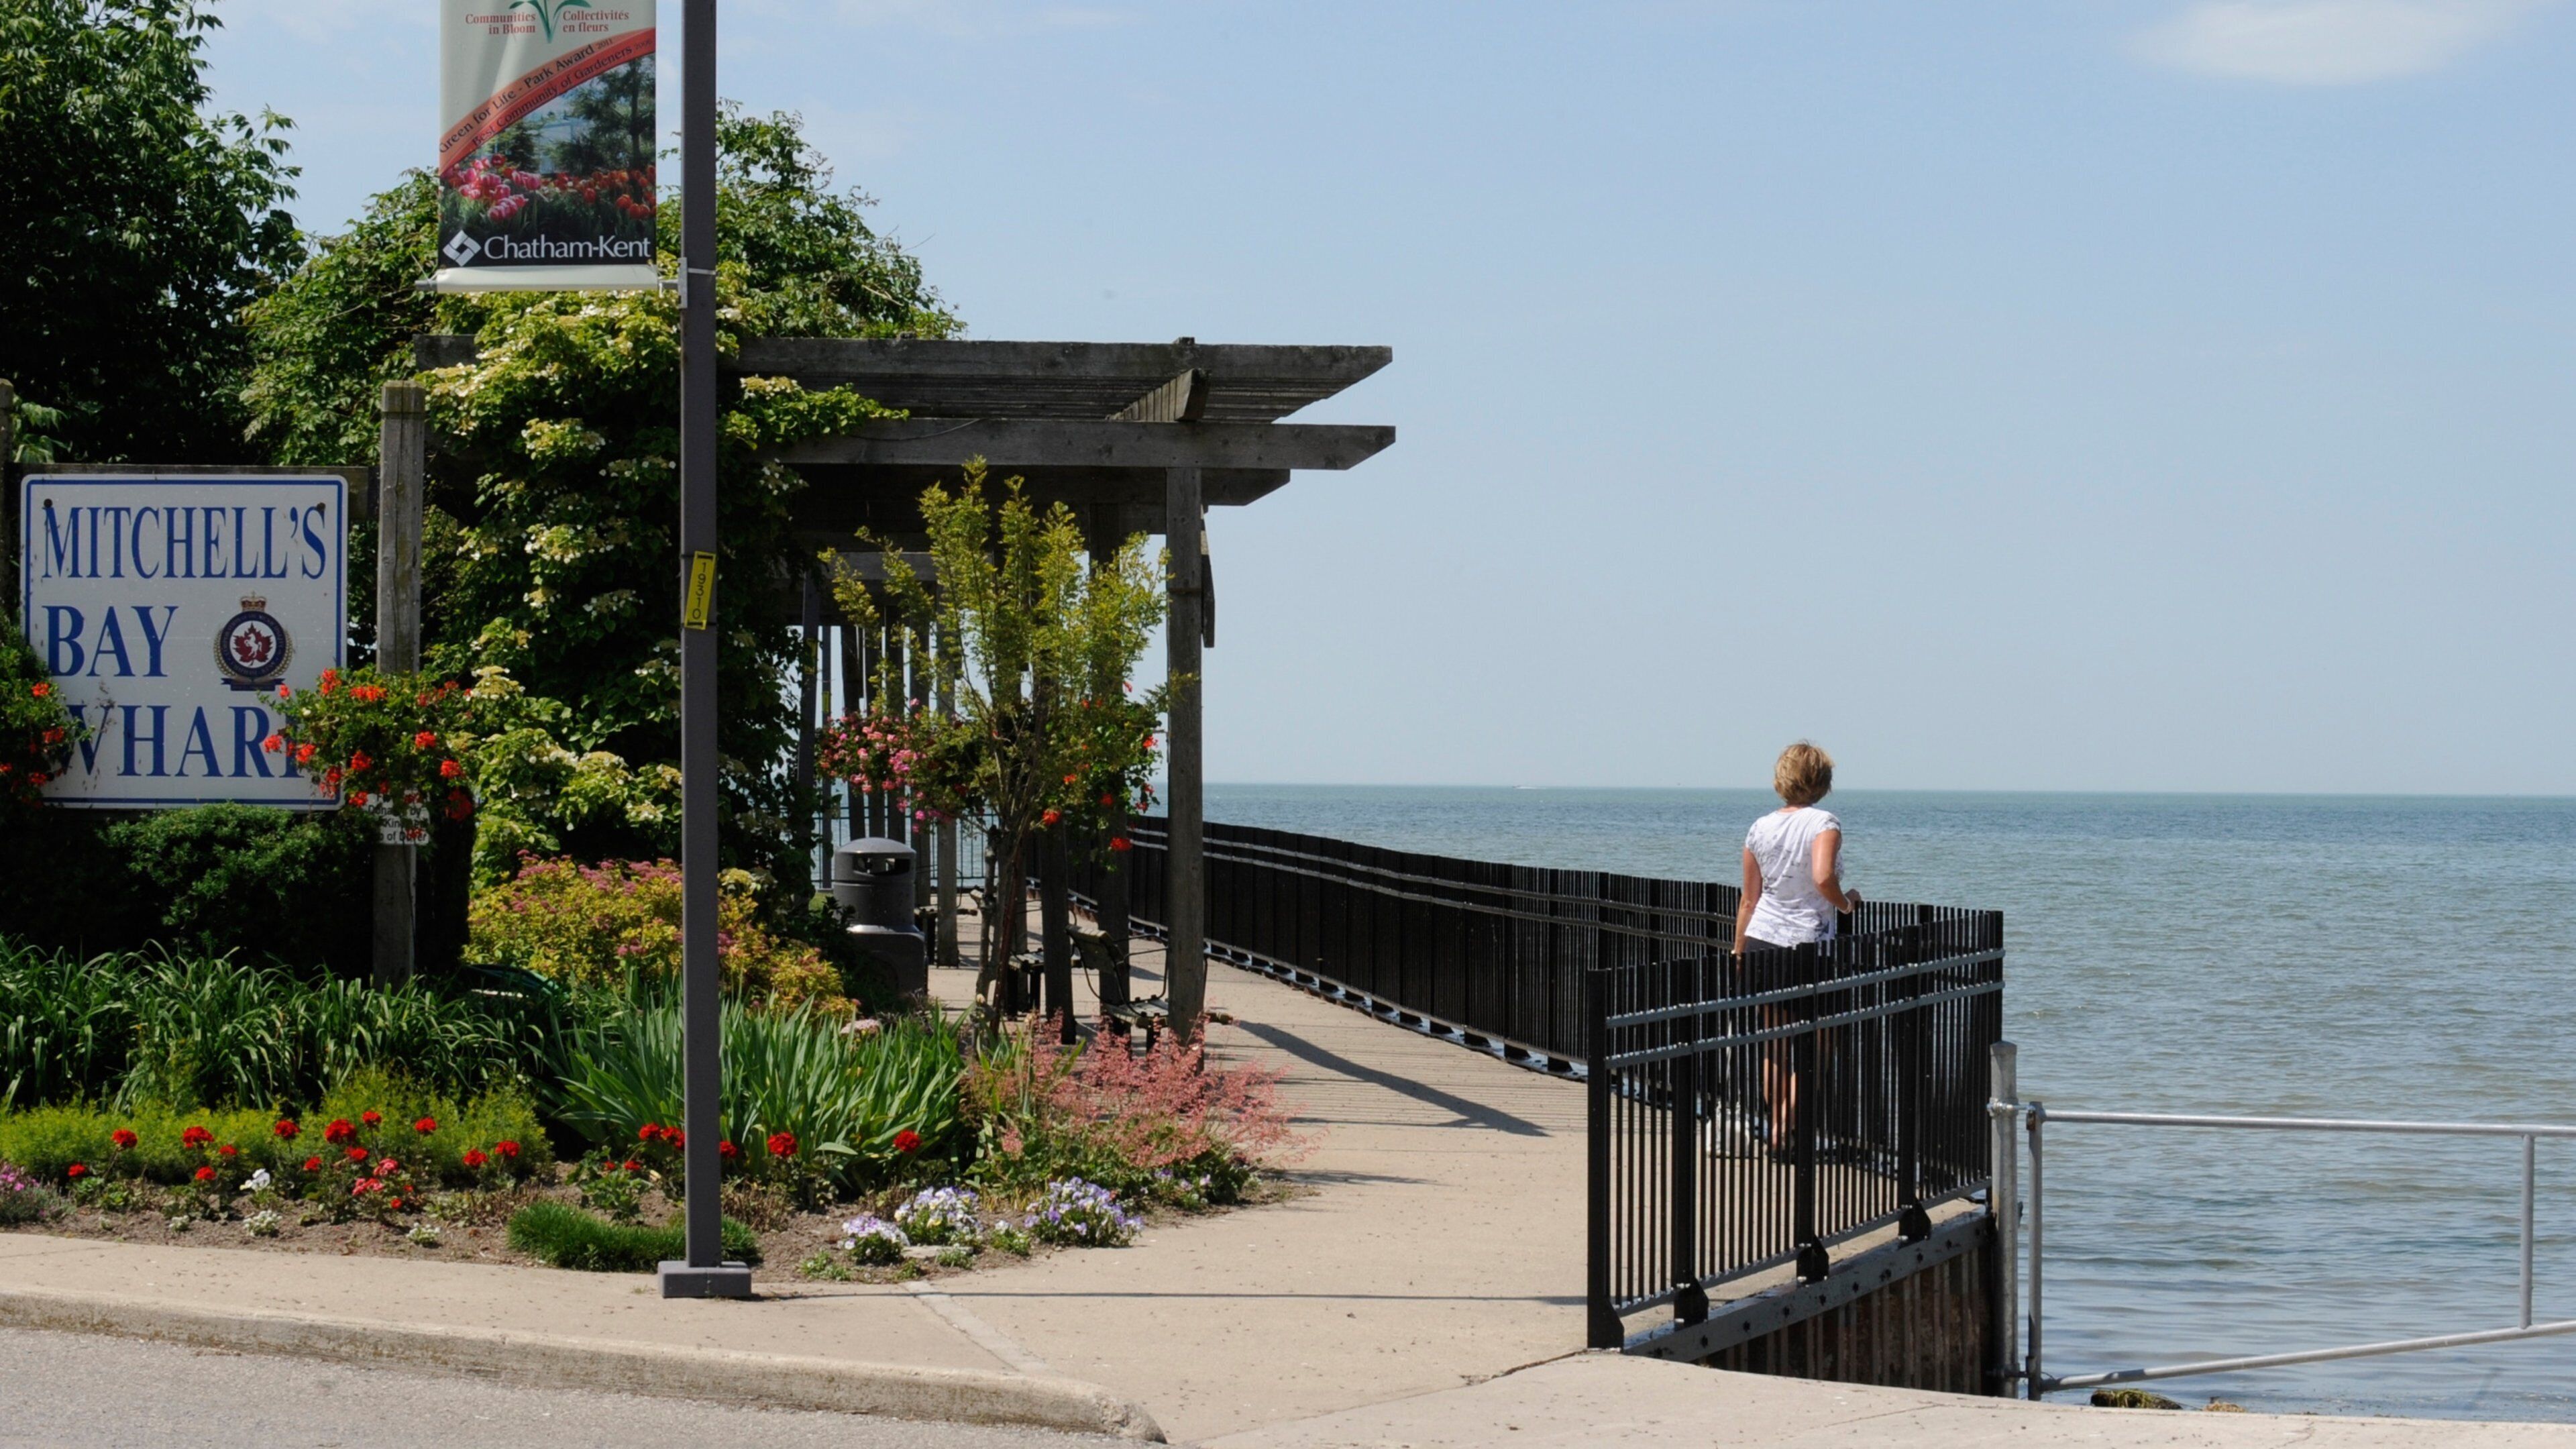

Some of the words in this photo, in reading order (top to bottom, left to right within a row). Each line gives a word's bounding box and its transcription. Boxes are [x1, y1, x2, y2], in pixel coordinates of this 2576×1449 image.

[466, 13, 536, 25] Communities
[563, 10, 629, 21] Collectivités
[488, 23, 499, 34] in
[503, 23, 536, 34] Bloom
[563, 24, 576, 32] en
[578, 21, 609, 33] fleurs
[439, 122, 473, 153] Green
[473, 107, 491, 125] for
[493, 90, 516, 109] Life
[524, 66, 553, 88] Park
[555, 44, 594, 71] Award
[597, 38, 614, 50] 2011
[472, 125, 496, 146] Best
[497, 82, 559, 127] Community
[561, 76, 573, 89] of
[575, 46, 633, 80] Gardeners
[484, 234, 651, 260] Chatham-Kent
[42, 505, 327, 580] MITCHELL'S
[42, 605, 179, 678] BAY
[387, 832, 396, 841] of
